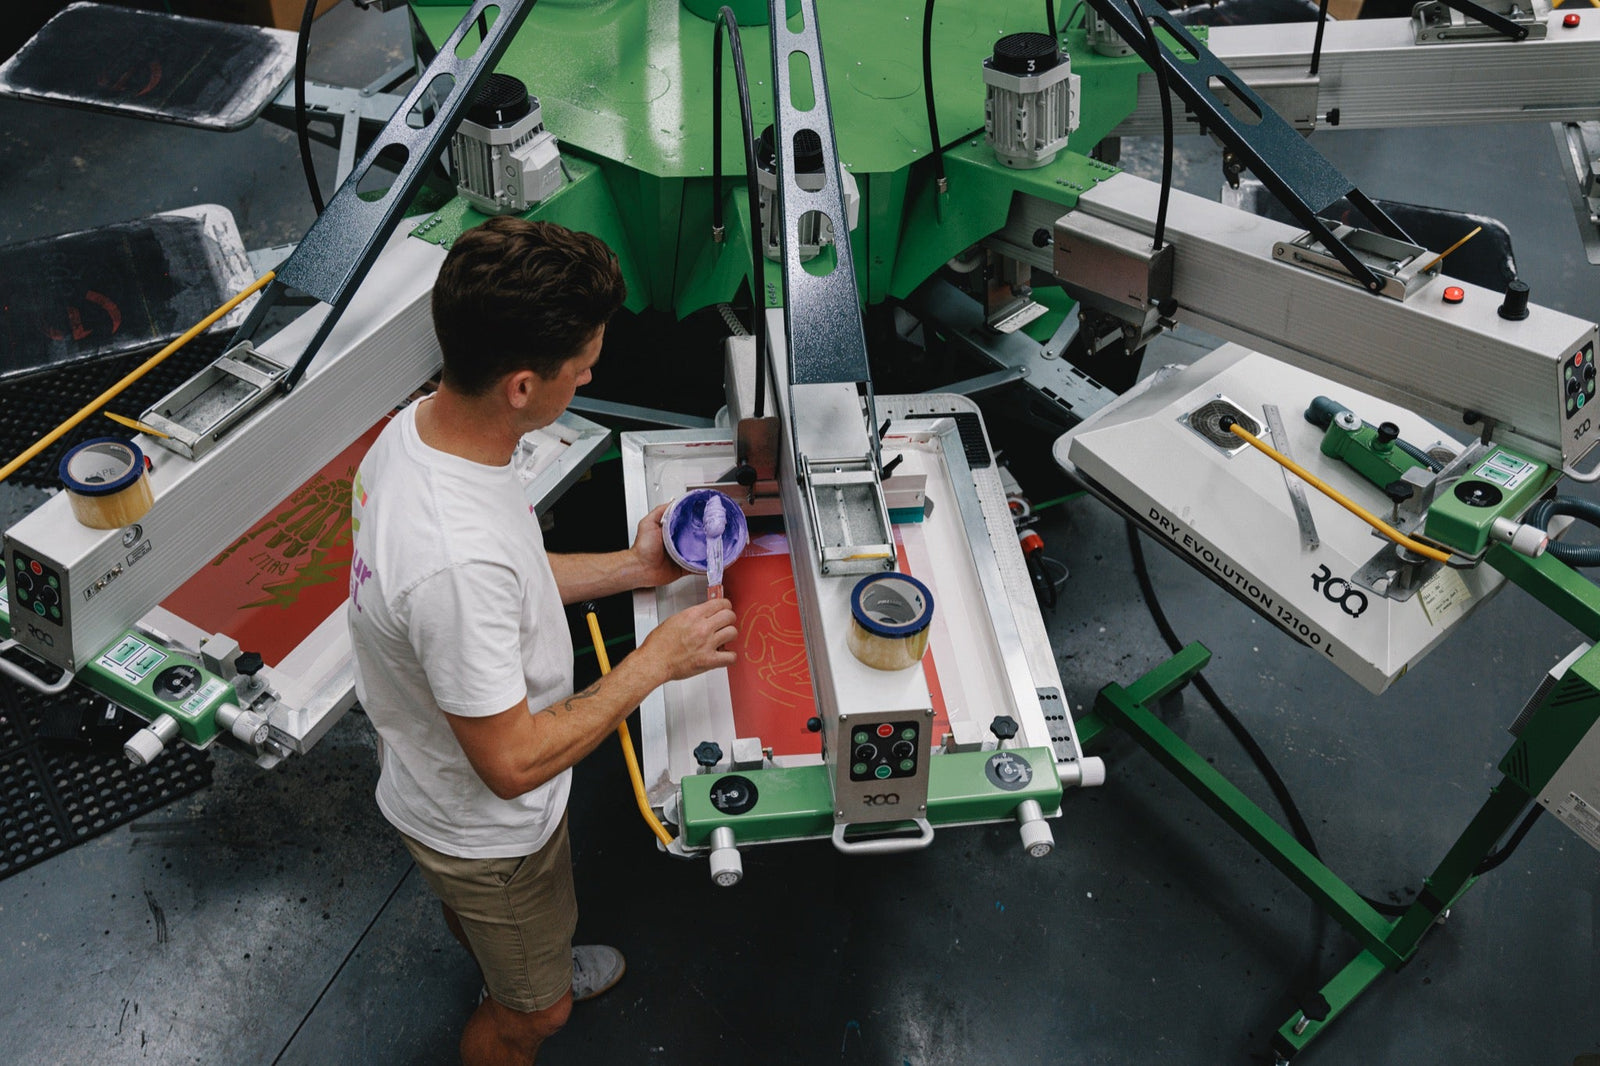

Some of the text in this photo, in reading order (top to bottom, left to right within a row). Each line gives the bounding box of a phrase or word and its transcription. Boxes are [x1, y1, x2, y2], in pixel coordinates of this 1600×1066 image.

[1027, 60, 1036, 72] 3
[496, 109, 503, 122] 1
[1149, 507, 1335, 658] DRY EVOLUTION 12100 L
[1310, 563, 1369, 619] ROQ
